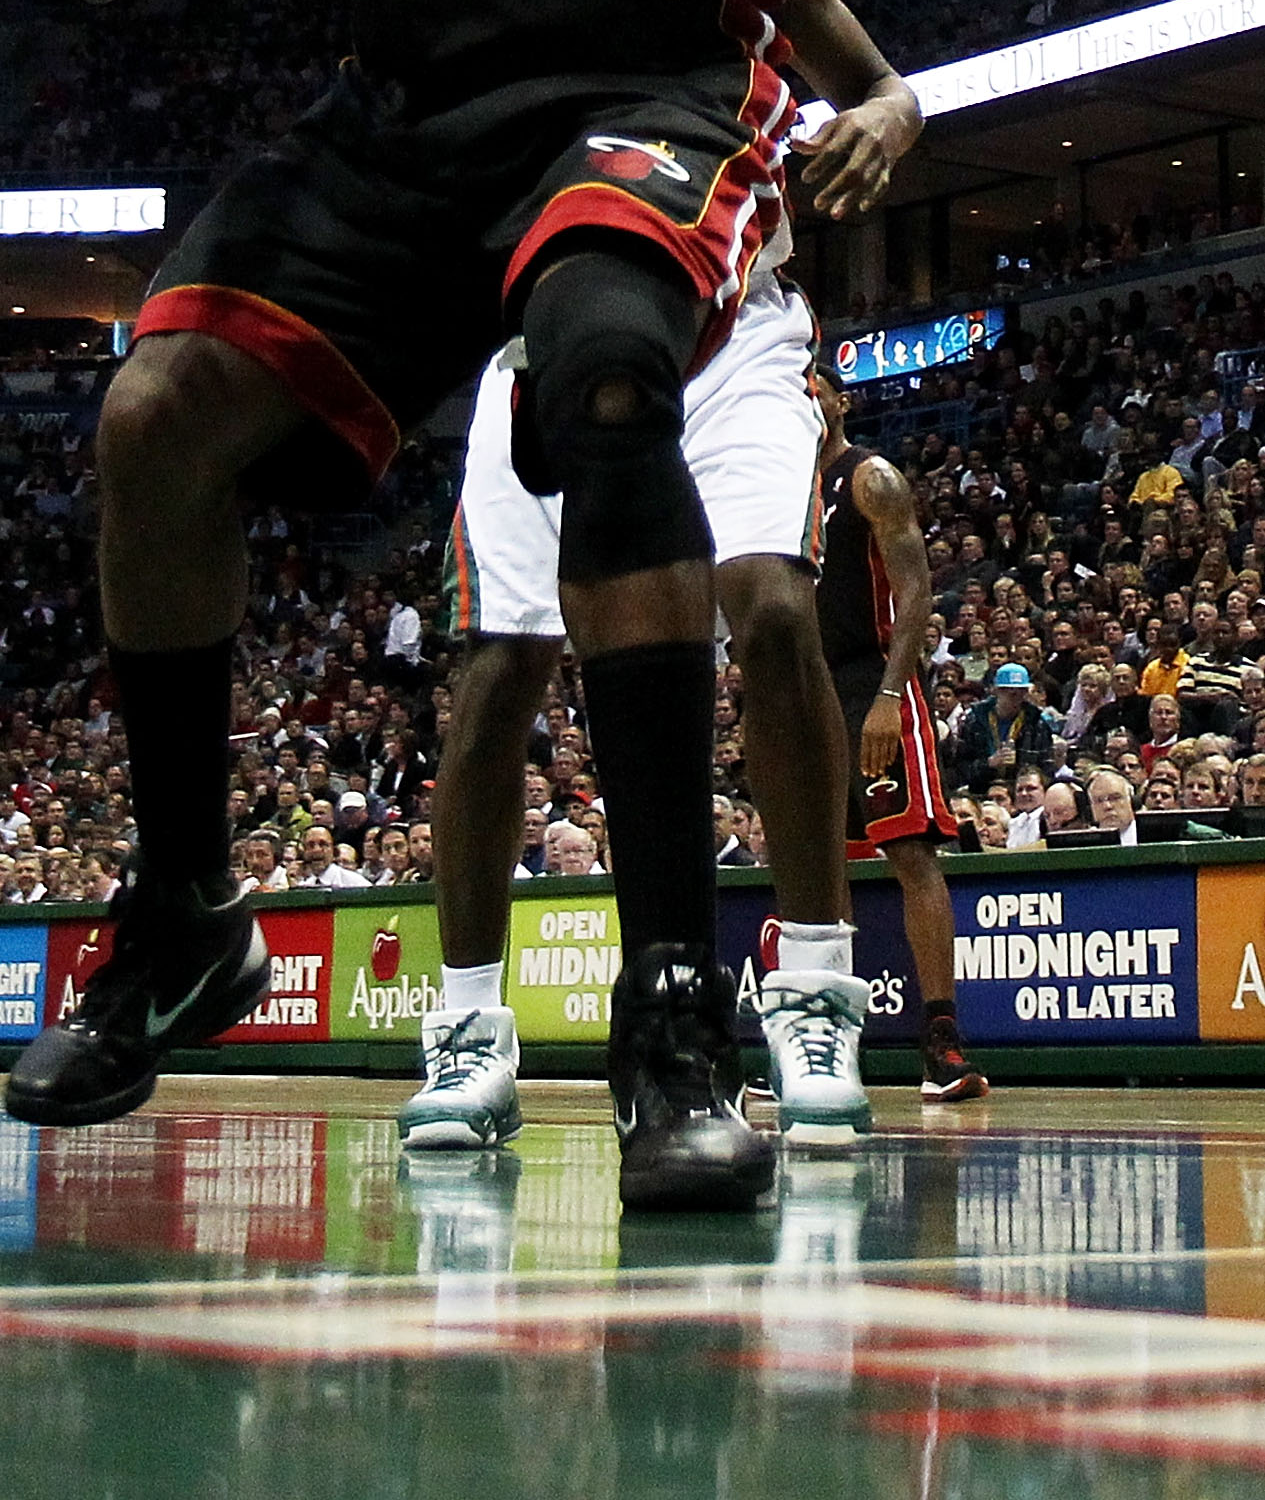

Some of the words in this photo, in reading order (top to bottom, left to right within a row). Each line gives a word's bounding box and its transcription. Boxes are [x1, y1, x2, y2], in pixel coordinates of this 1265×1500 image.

[540, 910, 607, 942] OPEN
[976, 891, 1062, 928] OPEN
[953, 928, 1179, 980] MIDNIGHT
[564, 993, 601, 1022] OR
[1015, 986, 1061, 1020] OR
[1067, 983, 1176, 1019] LATER
